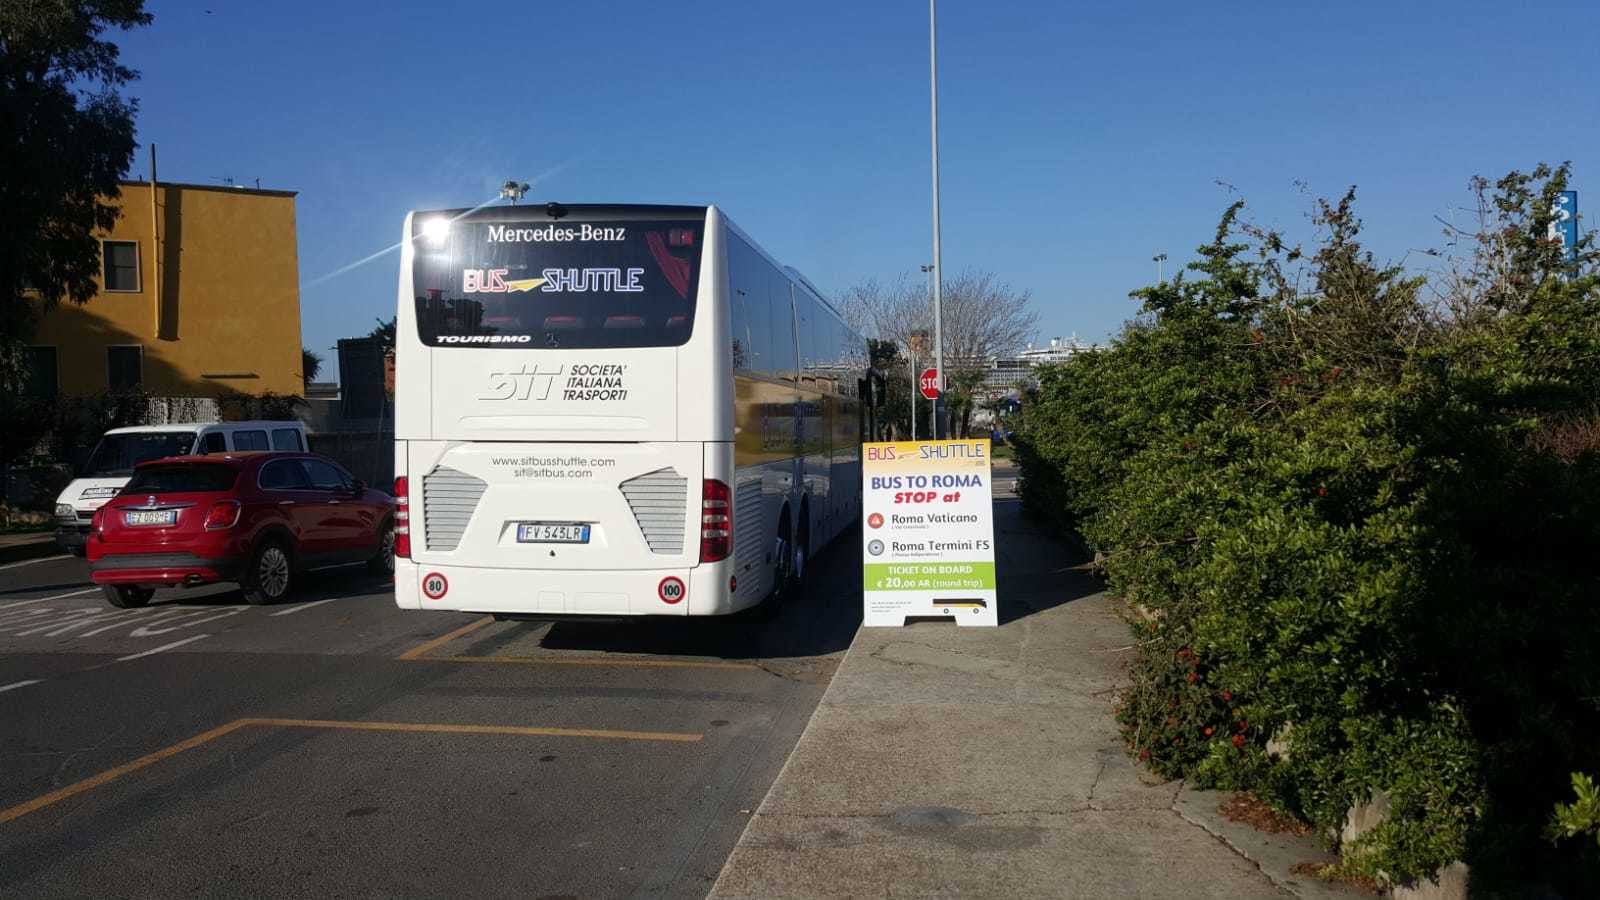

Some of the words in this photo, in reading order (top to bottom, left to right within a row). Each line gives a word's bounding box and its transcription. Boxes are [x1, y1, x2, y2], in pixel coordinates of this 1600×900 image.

[487, 224, 626, 242] Mercedes-Benz
[463, 268, 508, 293] BUS
[541, 267, 645, 293] SHUTTLE
[436, 335, 531, 343] TOURISMO
[571, 364, 627, 376] SOCIETA'
[566, 377, 623, 388] ITALIANA
[921, 377, 938, 390] STO
[562, 389, 628, 401] TRASPORTI
[868, 447, 896, 461] BUS
[919, 443, 985, 459] SHUTTLE
[492, 456, 616, 467] www.sitbusshuttle.com
[871, 476, 902, 490] BUS
[905, 475, 927, 488] TO
[932, 474, 982, 488] ROMA
[894, 492, 937, 503] STOP
[943, 491, 961, 503] at
[891, 514, 924, 524] Roma
[927, 512, 978, 523] Vaticano
[892, 541, 924, 551] Roma
[928, 540, 972, 551] Termini
[976, 540, 990, 550] FS
[888, 566, 919, 575] TICKET
[922, 566, 937, 574] ON
[940, 565, 973, 574] BOARD
[429, 581, 442, 591] 80
[664, 585, 680, 596] 100
